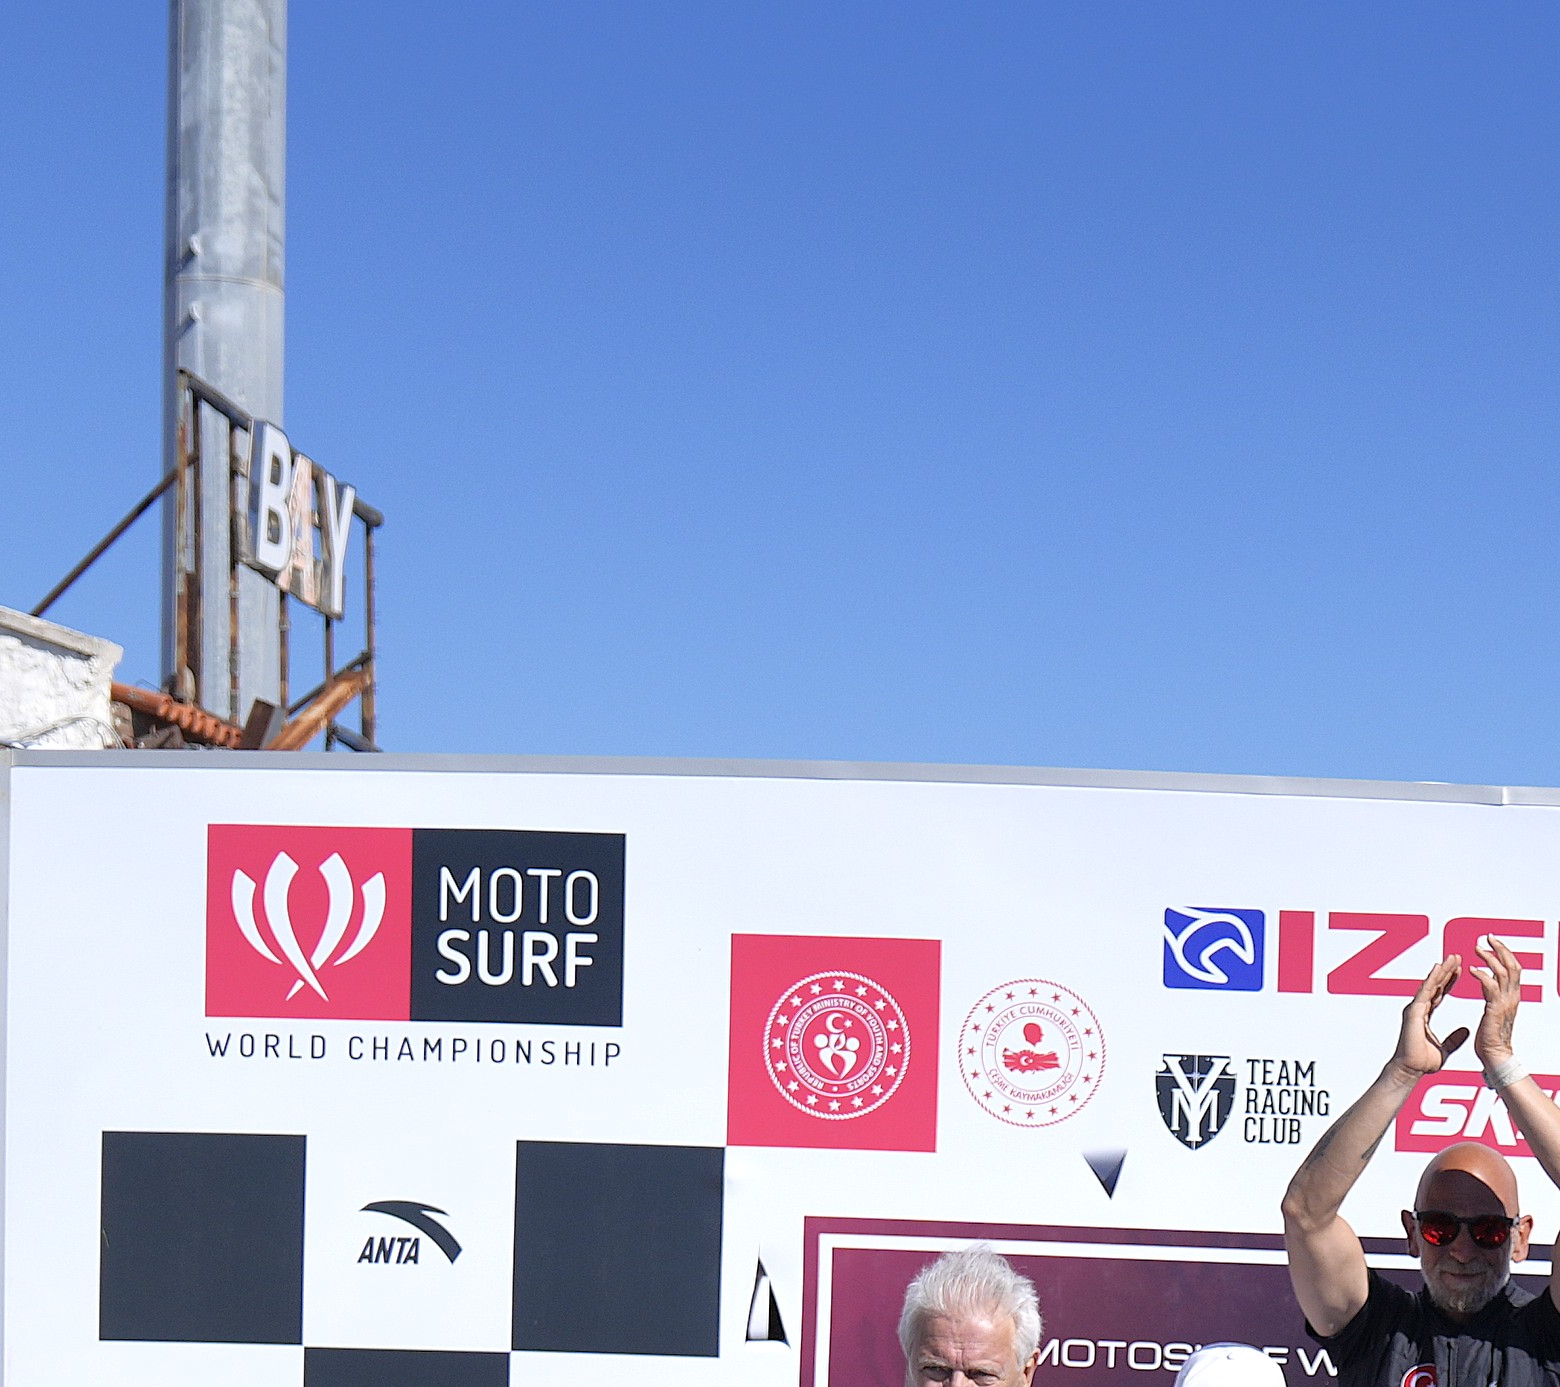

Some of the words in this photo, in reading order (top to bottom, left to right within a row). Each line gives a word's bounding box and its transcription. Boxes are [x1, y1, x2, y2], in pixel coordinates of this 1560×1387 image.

[438, 866, 600, 926] MOTO
[434, 928, 599, 988] SURF
[205, 1032, 327, 1060] WORLD
[348, 1035, 622, 1067] CHAMPIONSHIP
[1247, 1058, 1317, 1088] TEAM
[1245, 1087, 1330, 1117] RACING
[1244, 1115, 1303, 1145] CLUB
[356, 1236, 420, 1265] ANTA
